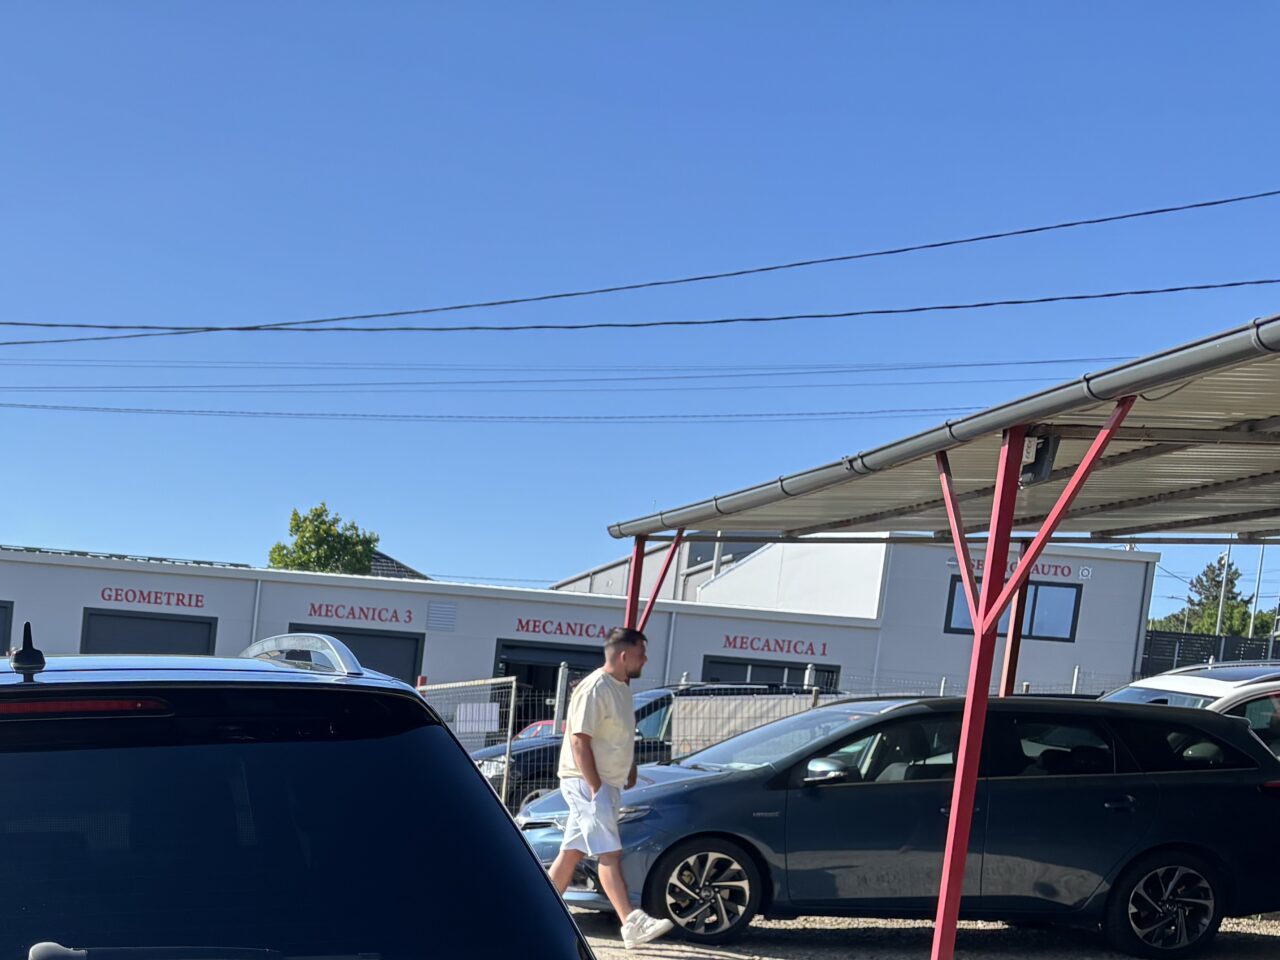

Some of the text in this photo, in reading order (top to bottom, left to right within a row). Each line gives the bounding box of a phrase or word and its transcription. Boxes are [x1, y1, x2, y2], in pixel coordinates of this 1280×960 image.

[1030, 563, 1072, 577] AUTO
[100, 587, 205, 608] GEOMETRIE
[308, 603, 413, 623] MECANICA 3
[515, 618, 606, 638] MECANICA
[722, 635, 828, 656] MECANICA 1
